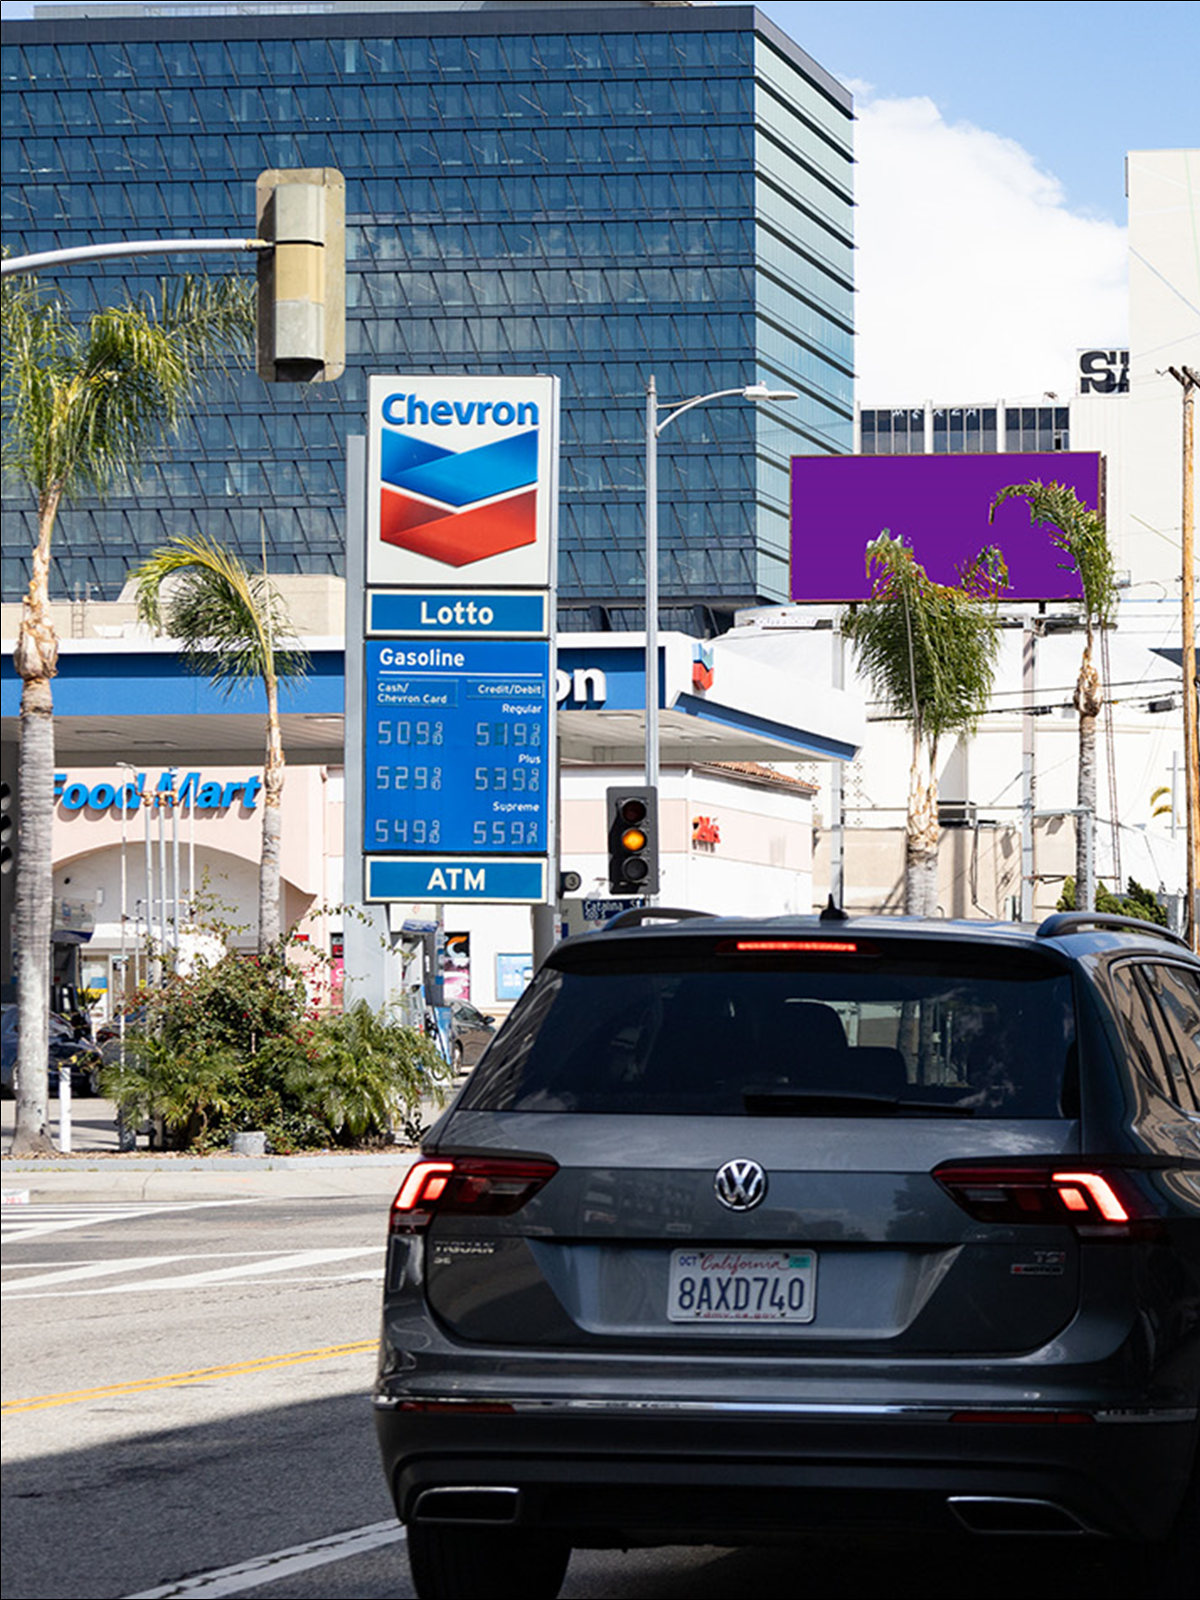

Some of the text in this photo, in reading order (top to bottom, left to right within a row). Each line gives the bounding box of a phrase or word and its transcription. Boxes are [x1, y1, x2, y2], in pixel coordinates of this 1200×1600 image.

[381, 393, 540, 426] Chevron
[420, 601, 494, 625] Lotto
[379, 648, 465, 667] Gasoline
[377, 682, 410, 693] Cash/
[477, 684, 542, 696] Credit/Debit
[377, 694, 447, 704] Chevron Card
[501, 703, 543, 715] Regular
[518, 753, 541, 764] Plus
[53, 772, 262, 809] Food Mart
[493, 801, 540, 812] Supreme
[427, 868, 486, 891] ATM
[679, 1256, 697, 1266] OCT
[701, 1254, 790, 1275] California
[678, 1277, 804, 1311] 8AXD740
